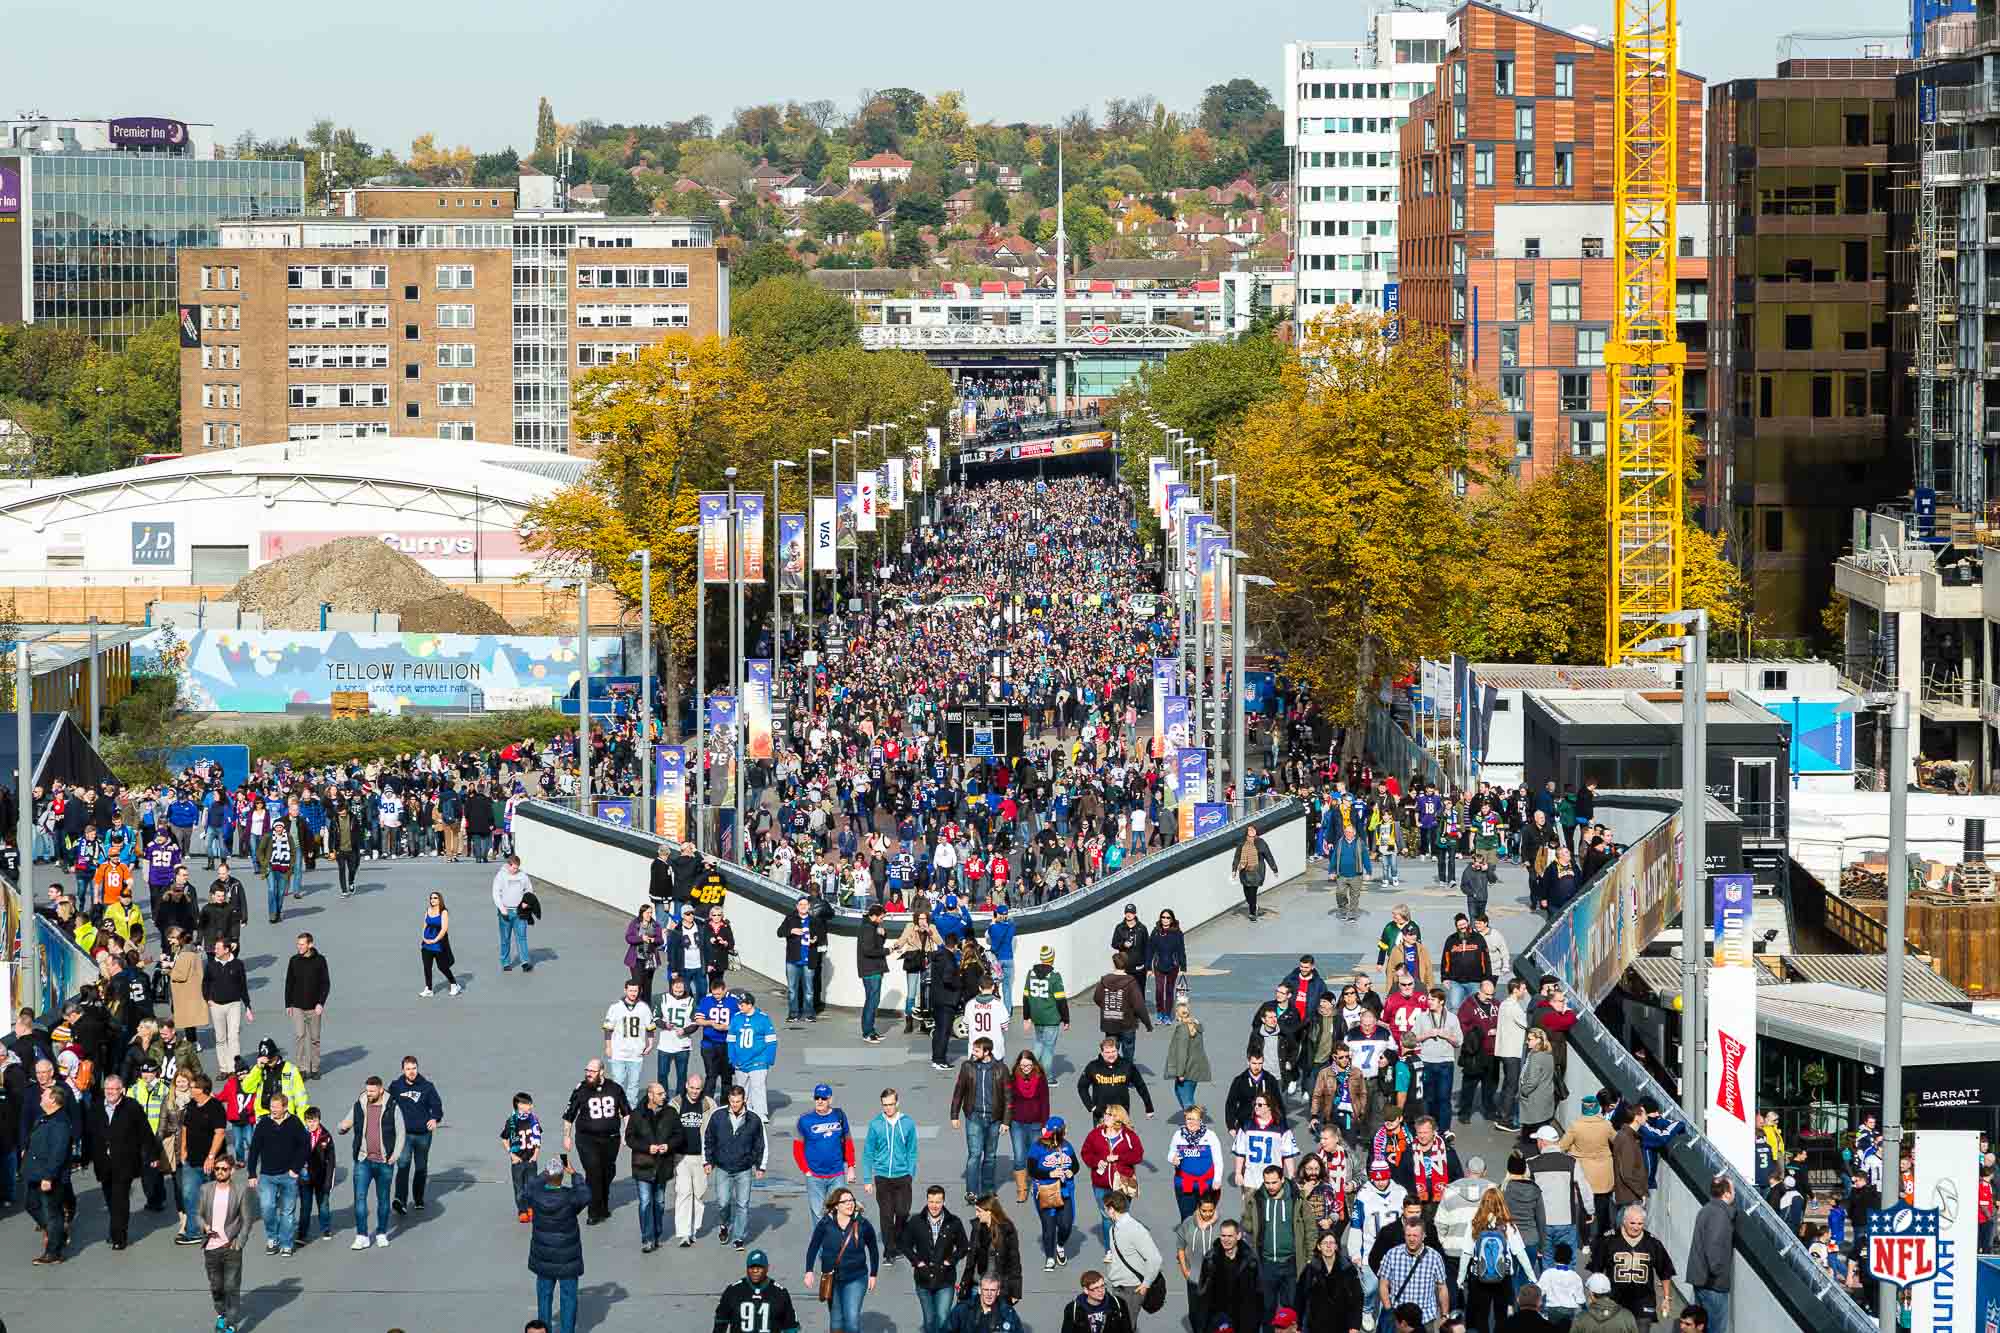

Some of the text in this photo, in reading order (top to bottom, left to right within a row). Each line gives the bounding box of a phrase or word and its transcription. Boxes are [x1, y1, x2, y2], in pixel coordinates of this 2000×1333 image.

[113, 125, 166, 139] Premier Inn
[1388, 287, 1397, 340] NOOTEL
[861, 326, 958, 344] EMBLEY
[379, 533, 473, 555] Currys
[819, 521, 831, 548] VISA
[326, 663, 481, 680] YELLOW PAVILION
[1482, 820, 1495, 836] 12
[151, 851, 172, 867] 29
[108, 872, 120, 887] 18
[1030, 979, 1049, 999] 52
[667, 1007, 687, 1028] 15
[709, 1007, 730, 1025] 99
[974, 1012, 992, 1032] 90
[623, 1016, 640, 1038] 18
[739, 1027, 754, 1049] 10
[1360, 1045, 1376, 1070] 7
[1723, 1037, 1742, 1115] Budweiser
[1922, 1089, 1980, 1100] BARRATT
[588, 1096, 616, 1119] 88
[1249, 1136, 1273, 1165] 51
[1759, 1153, 1768, 1168] 3
[1613, 1251, 1650, 1284] 25
[740, 1301, 771, 1333] 91
